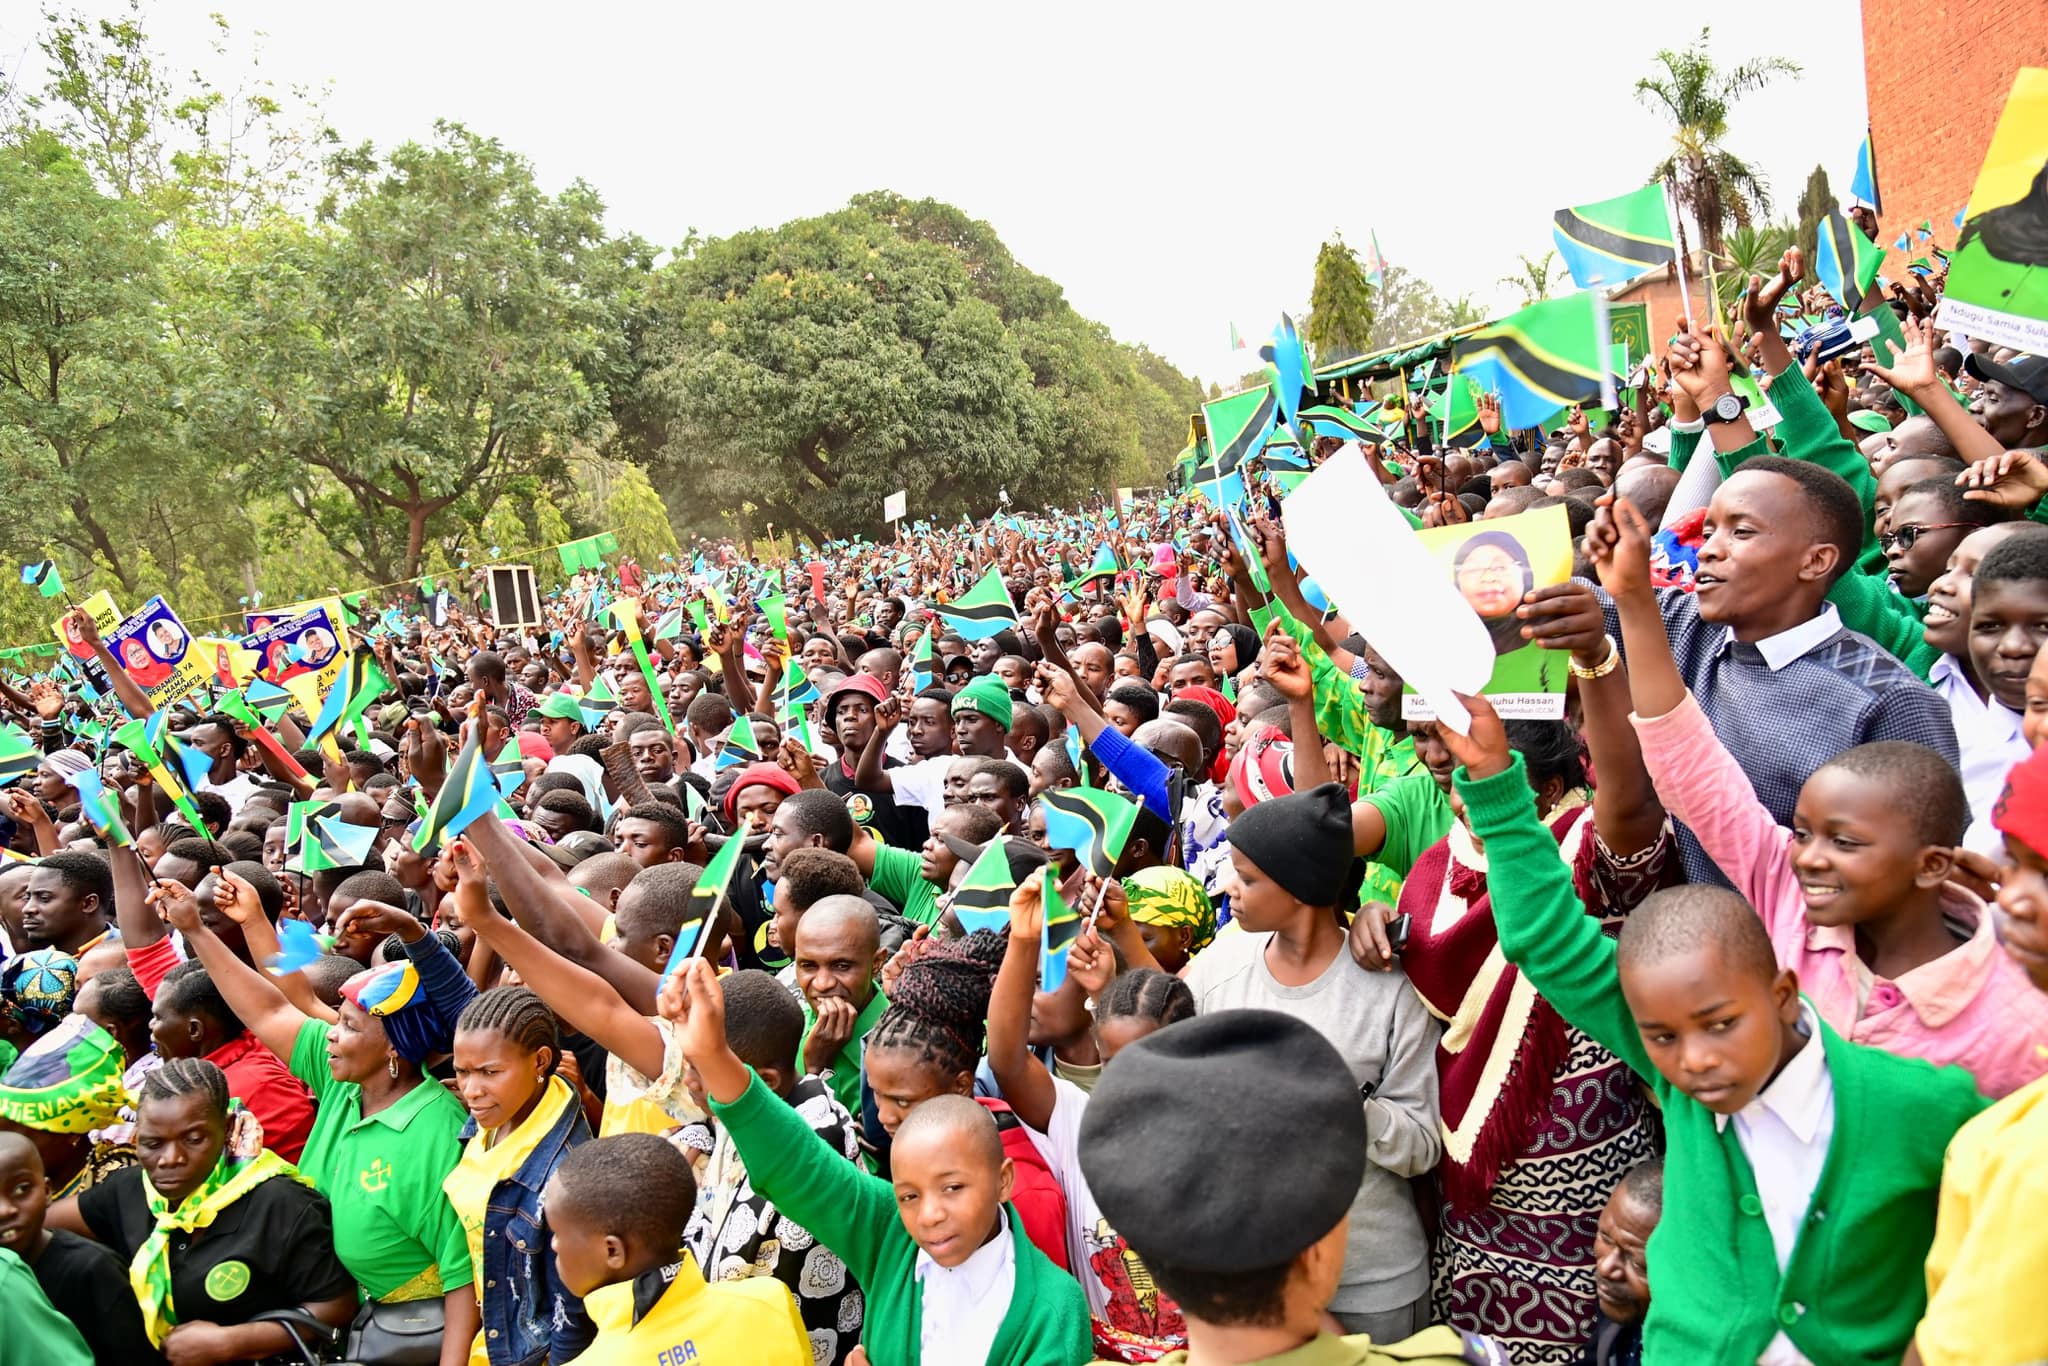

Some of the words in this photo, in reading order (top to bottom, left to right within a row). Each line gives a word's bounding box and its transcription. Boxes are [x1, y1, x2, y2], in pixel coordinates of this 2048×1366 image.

[1949, 305, 1983, 322] Ndugu
[1987, 315, 2021, 331] Samia
[95, 608, 112, 624] MIHO
[148, 670, 183, 699] PERAMIHO
[183, 662, 194, 672] YA
[164, 677, 186, 695] MAMA
[1517, 697, 1554, 705] Hassan
[657, 1339, 698, 1366] FIBA
